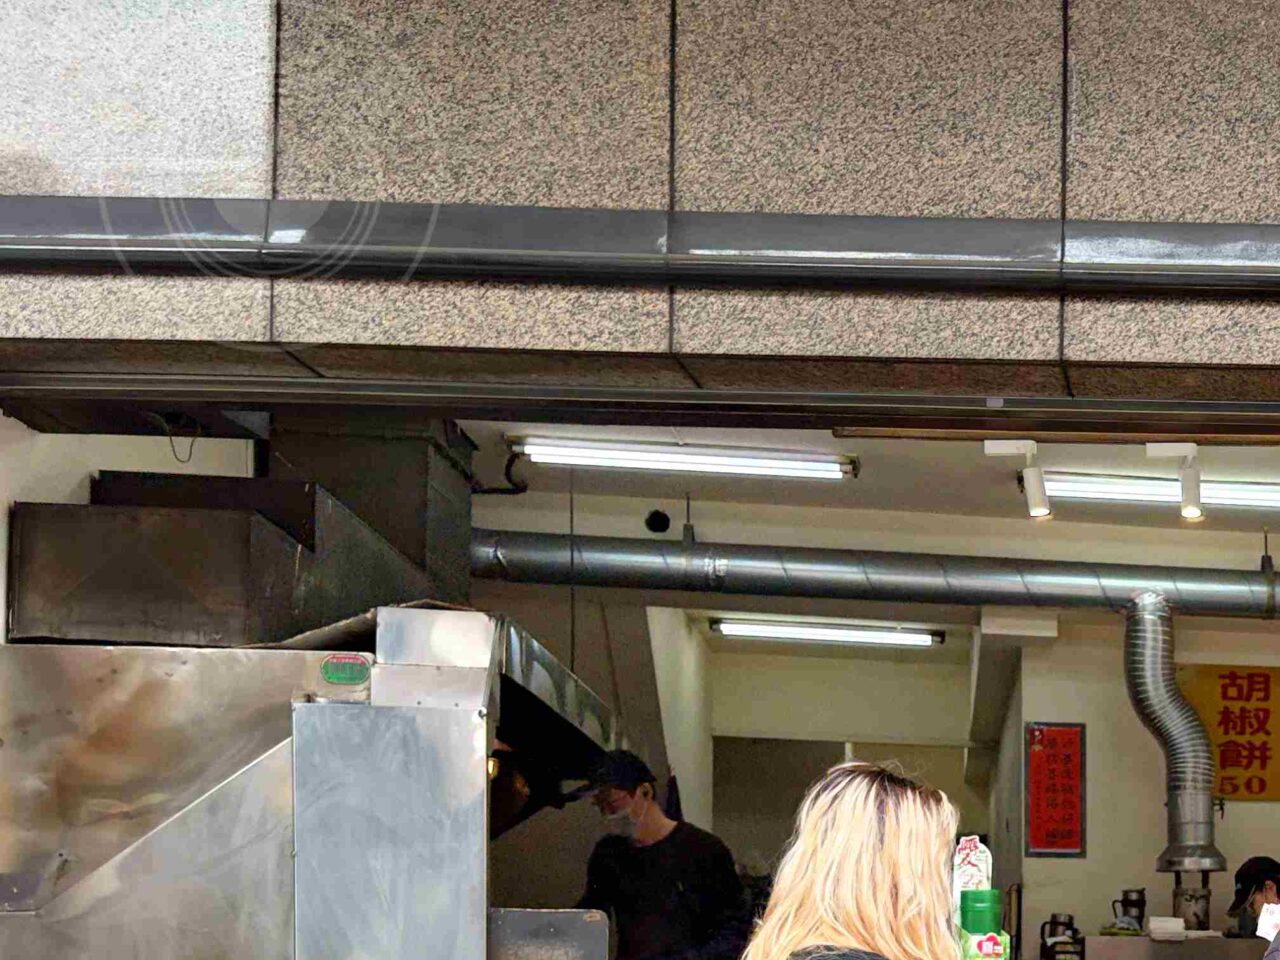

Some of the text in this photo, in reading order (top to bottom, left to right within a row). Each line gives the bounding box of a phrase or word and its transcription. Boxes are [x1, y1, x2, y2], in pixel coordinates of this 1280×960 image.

[1217, 671, 1272, 770] 胡椒餅
[1218, 776, 1267, 795] 50
